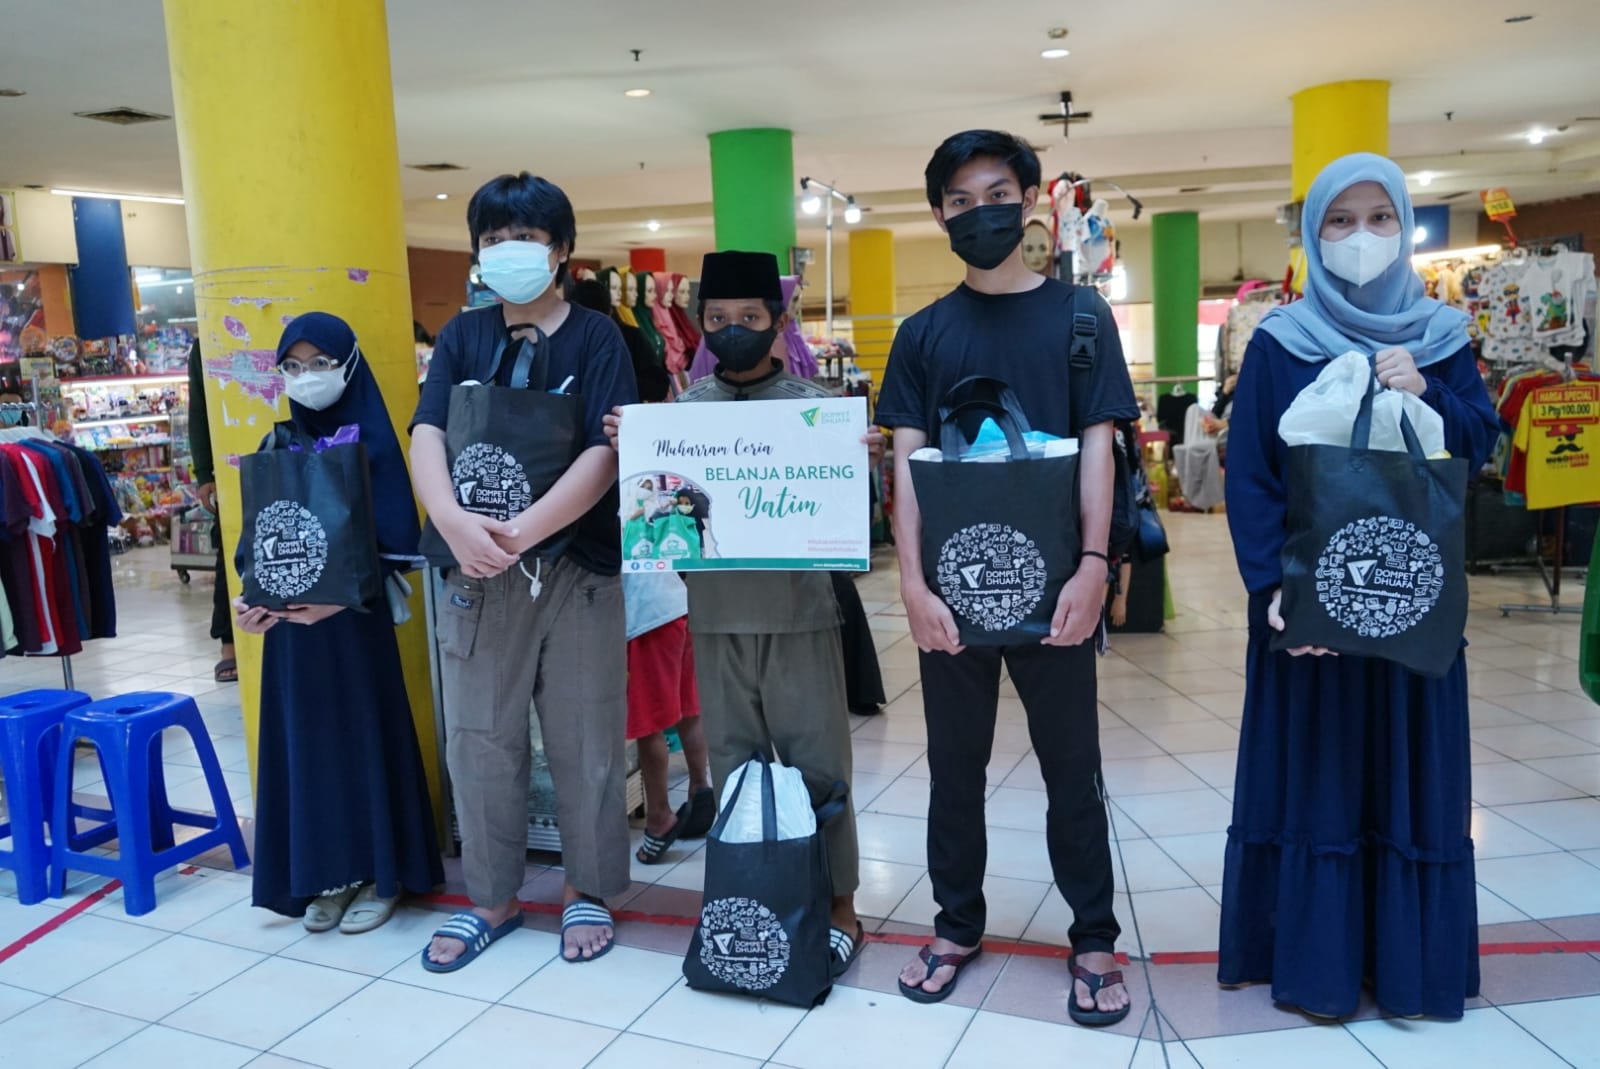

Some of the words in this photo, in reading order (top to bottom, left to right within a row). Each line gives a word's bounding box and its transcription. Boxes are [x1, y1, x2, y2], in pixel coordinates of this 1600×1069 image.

[1540, 391, 1563, 401] HARGA
[1564, 389, 1592, 400] SPECIAL
[653, 438, 728, 457] Muharram
[734, 438, 774, 457] Ceria
[705, 466, 780, 481] BELANJA
[785, 464, 854, 480] BARENG
[476, 488, 507, 497] DOMPET
[476, 496, 507, 505] DHUAFA
[738, 485, 822, 520] Yatim
[277, 539, 305, 548] DOMPET
[277, 546, 306, 556] DHUAFA
[985, 569, 1020, 578] DOMPET
[1374, 568, 1416, 581] DOMPET
[985, 577, 1021, 586] DHUAFA
[1374, 576, 1414, 590] DHUAFA
[734, 939, 766, 947] DOMPET
